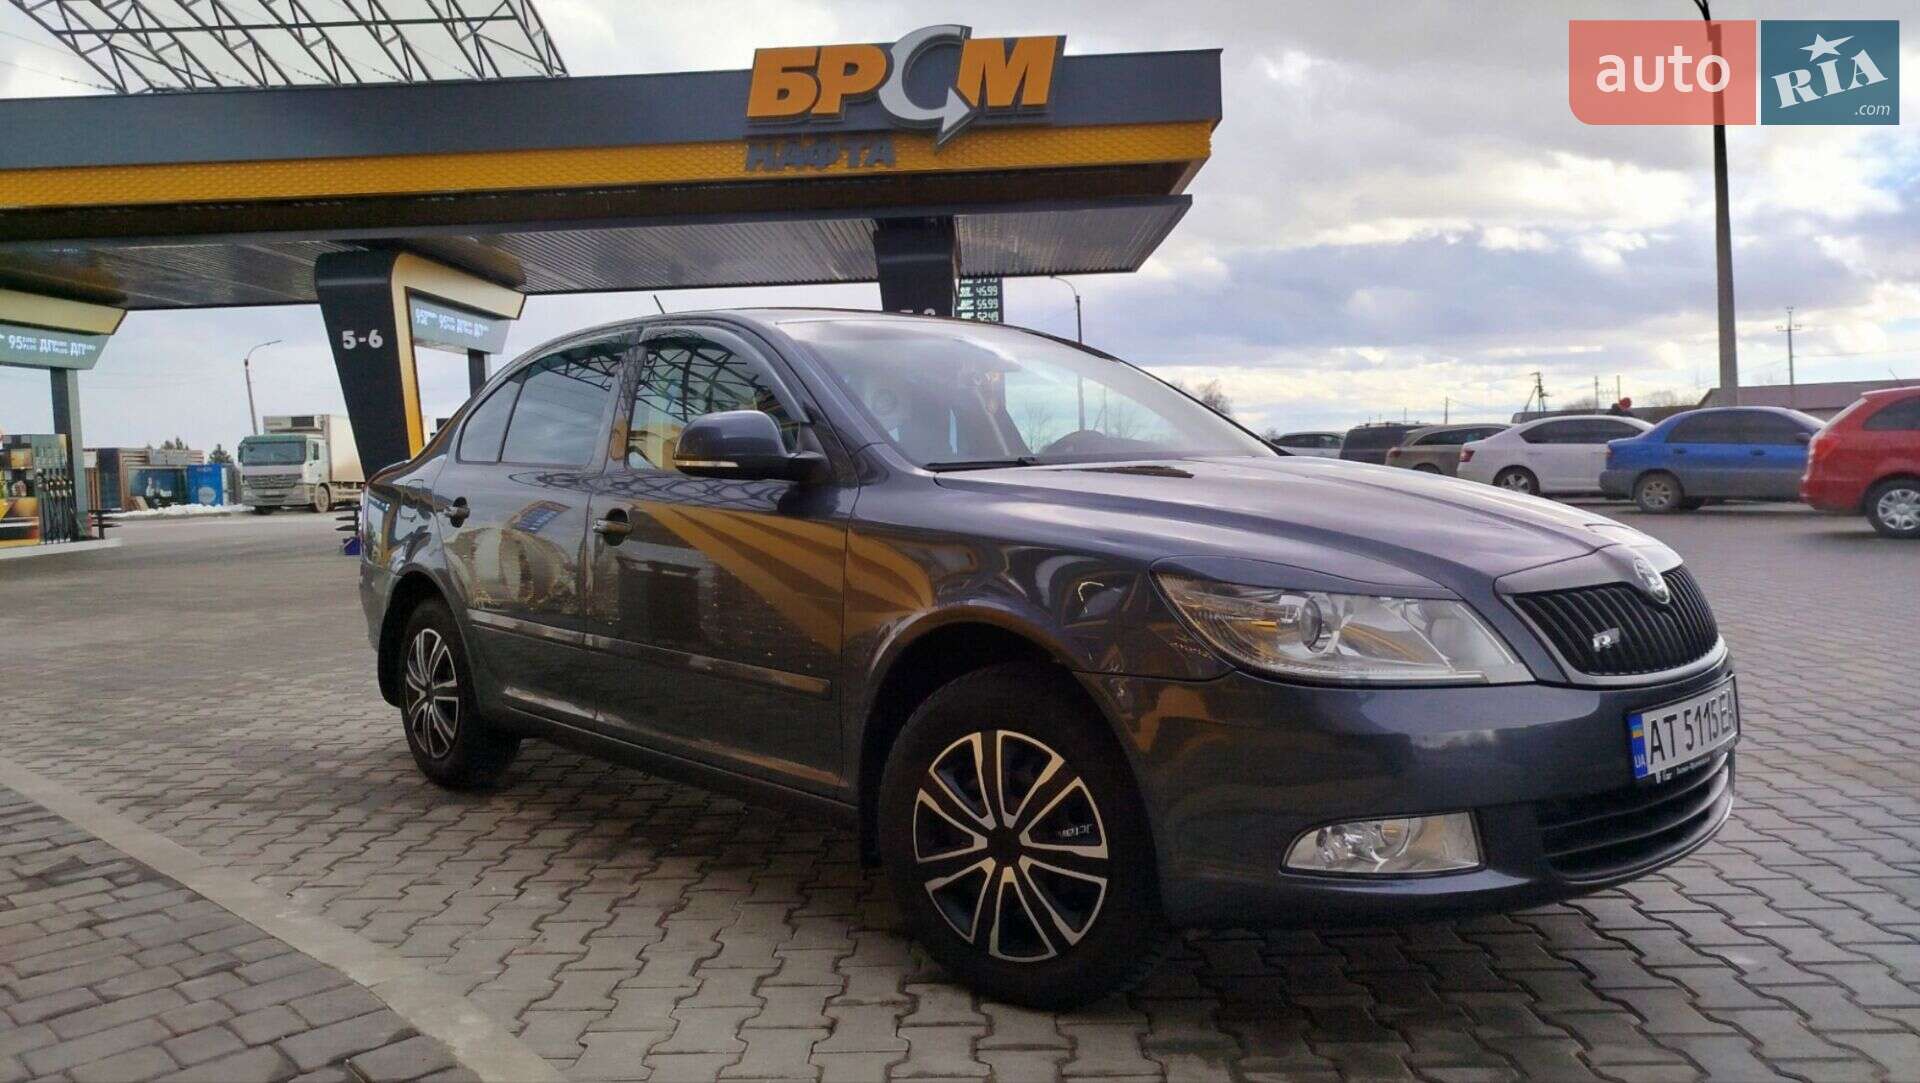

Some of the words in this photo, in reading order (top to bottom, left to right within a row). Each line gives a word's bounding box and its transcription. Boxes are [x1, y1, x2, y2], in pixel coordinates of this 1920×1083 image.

[746, 25, 1063, 144] БРСМ
[342, 329, 383, 350] 5-6
[1650, 714, 1677, 765] AT
[1684, 697, 1719, 751] 5115
[1633, 754, 1647, 769] UA
